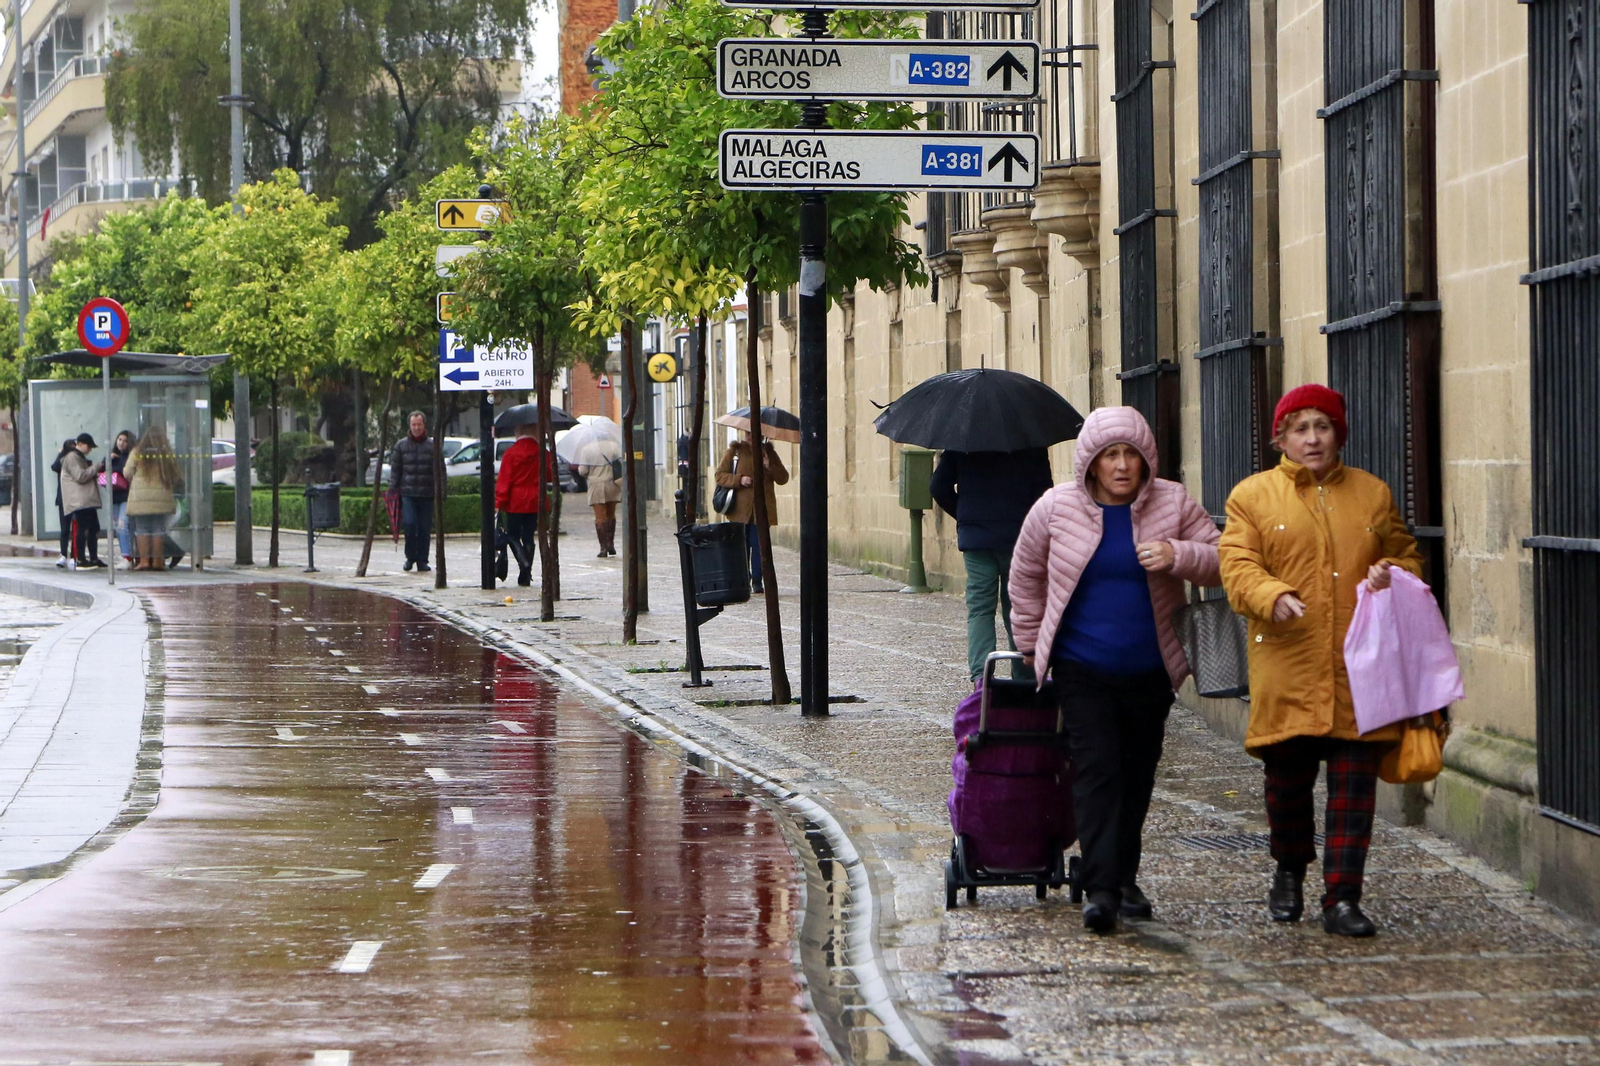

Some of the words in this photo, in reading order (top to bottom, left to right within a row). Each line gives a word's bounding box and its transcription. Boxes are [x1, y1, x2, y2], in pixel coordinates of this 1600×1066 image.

[731, 48, 842, 67] GRANADA
[911, 61, 969, 79] A-382
[731, 70, 811, 89] ARCOS
[732, 138, 827, 158] MALAGA
[732, 160, 861, 179] ALGECIRAS
[925, 152, 979, 170] A-381
[98, 315, 108, 328] P
[96, 332, 110, 340] BUS
[484, 369, 524, 377] ABIERTO
